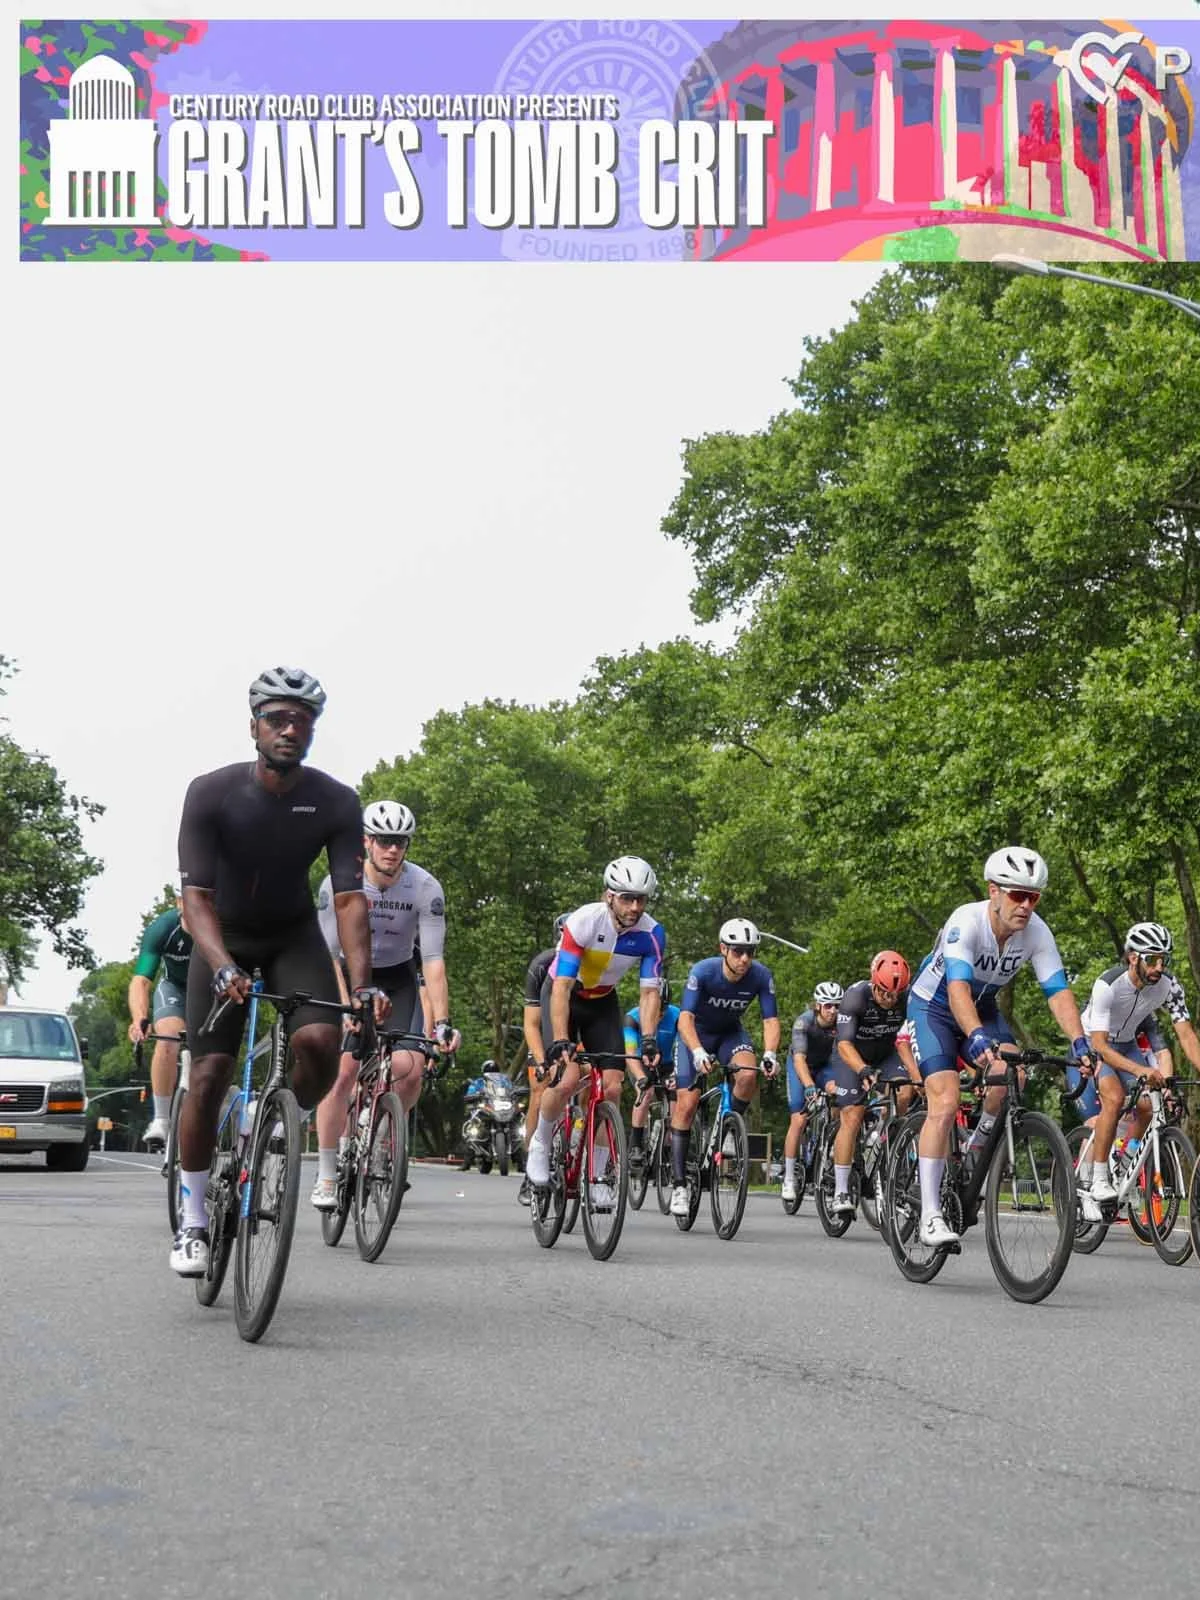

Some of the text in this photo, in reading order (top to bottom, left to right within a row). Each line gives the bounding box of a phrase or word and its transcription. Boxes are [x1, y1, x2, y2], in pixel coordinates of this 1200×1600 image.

[373, 900, 413, 912] PROGRAM
[974, 954, 1022, 973] NYCC
[708, 996, 749, 1009] NYCC
